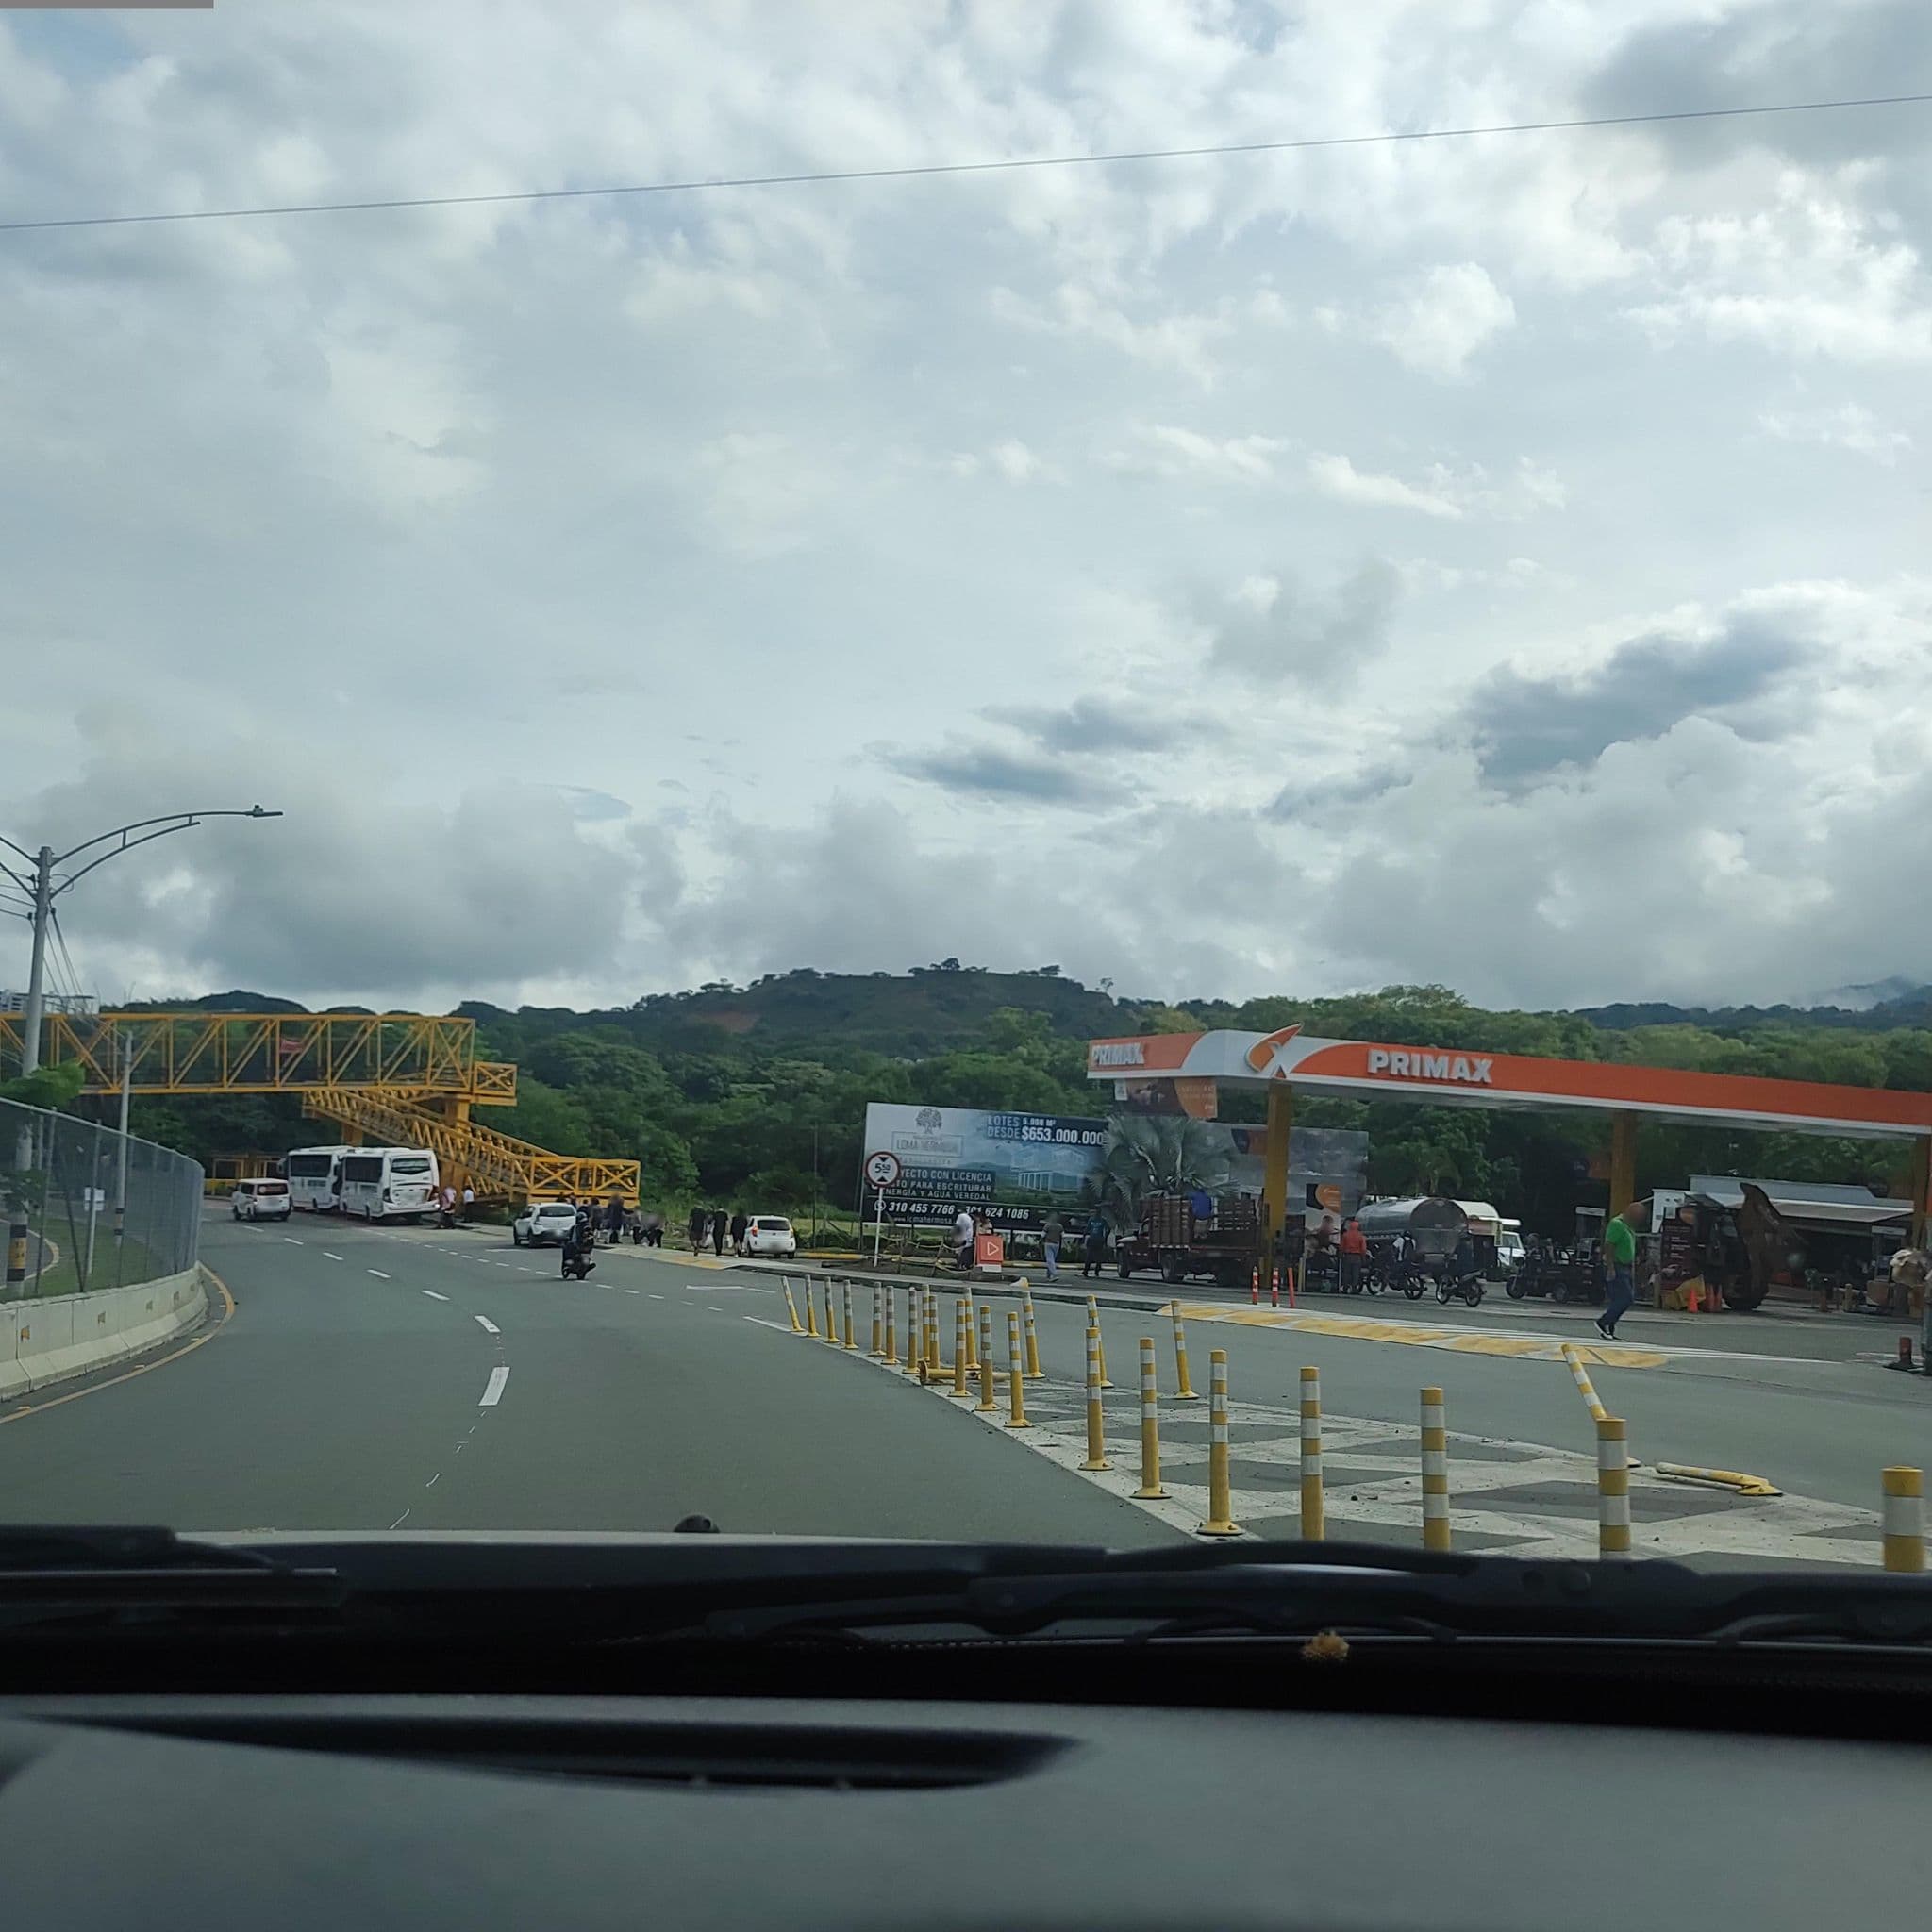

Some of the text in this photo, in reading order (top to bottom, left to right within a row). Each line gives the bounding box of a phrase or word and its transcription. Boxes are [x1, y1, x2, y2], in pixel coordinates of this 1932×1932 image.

[1091, 1041, 1144, 1065] PRIMAX
[1367, 1049, 1493, 1083] PRIMAX
[987, 1115, 1021, 1127] LOTES
[987, 1125, 1103, 1145] DESDE $653.000.000
[899, 1168, 992, 1183] YECTO CON LICENCIA
[910, 1180, 934, 1190] PARA
[937, 1181, 991, 1193] ESCRITURAR
[928, 1190, 951, 1199] AGUA
[953, 1191, 991, 1201] VEREDAL
[888, 1201, 908, 1212] 310
[909, 1202, 928, 1213] 455
[930, 1203, 956, 1214] 7766
[985, 1207, 1003, 1218] 624
[1006, 1208, 1029, 1220] 1086
